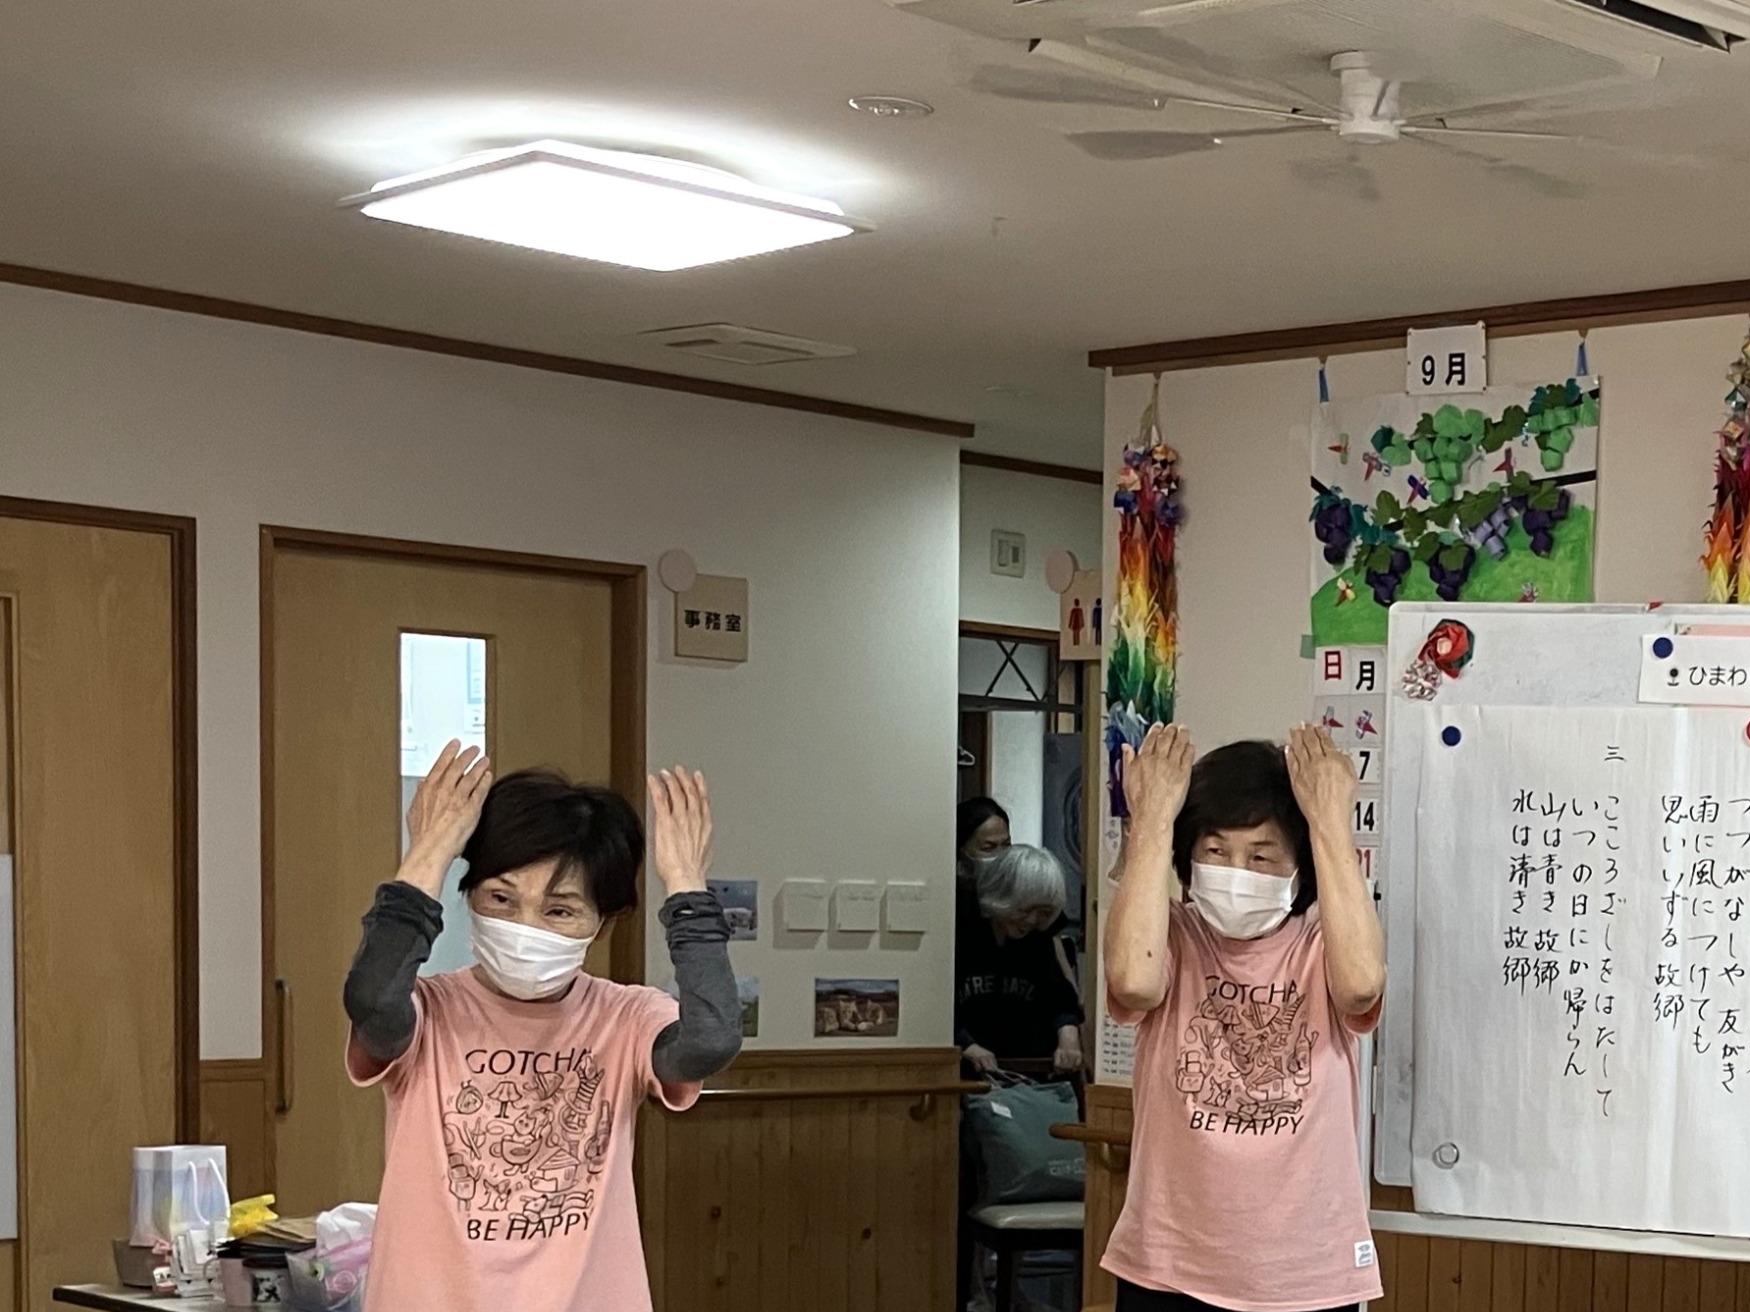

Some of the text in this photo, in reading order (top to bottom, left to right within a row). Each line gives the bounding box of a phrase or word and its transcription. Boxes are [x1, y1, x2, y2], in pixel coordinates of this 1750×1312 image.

[1421, 352, 1467, 387] 9月
[684, 609, 741, 633] 事務室
[1324, 651, 1342, 680] 日
[1356, 661, 1375, 691] 月
[1359, 751, 1371, 780] 7
[1354, 801, 1375, 831] 14
[1688, 797, 1723, 1055] 雨に風につけても
[1595, 796, 1627, 1118] こころざしをはたして
[1205, 975, 1297, 1003] GOTCHA
[1189, 1110, 1305, 1137] BE HAPPY
[467, 1212, 591, 1241] BE HAPPY
